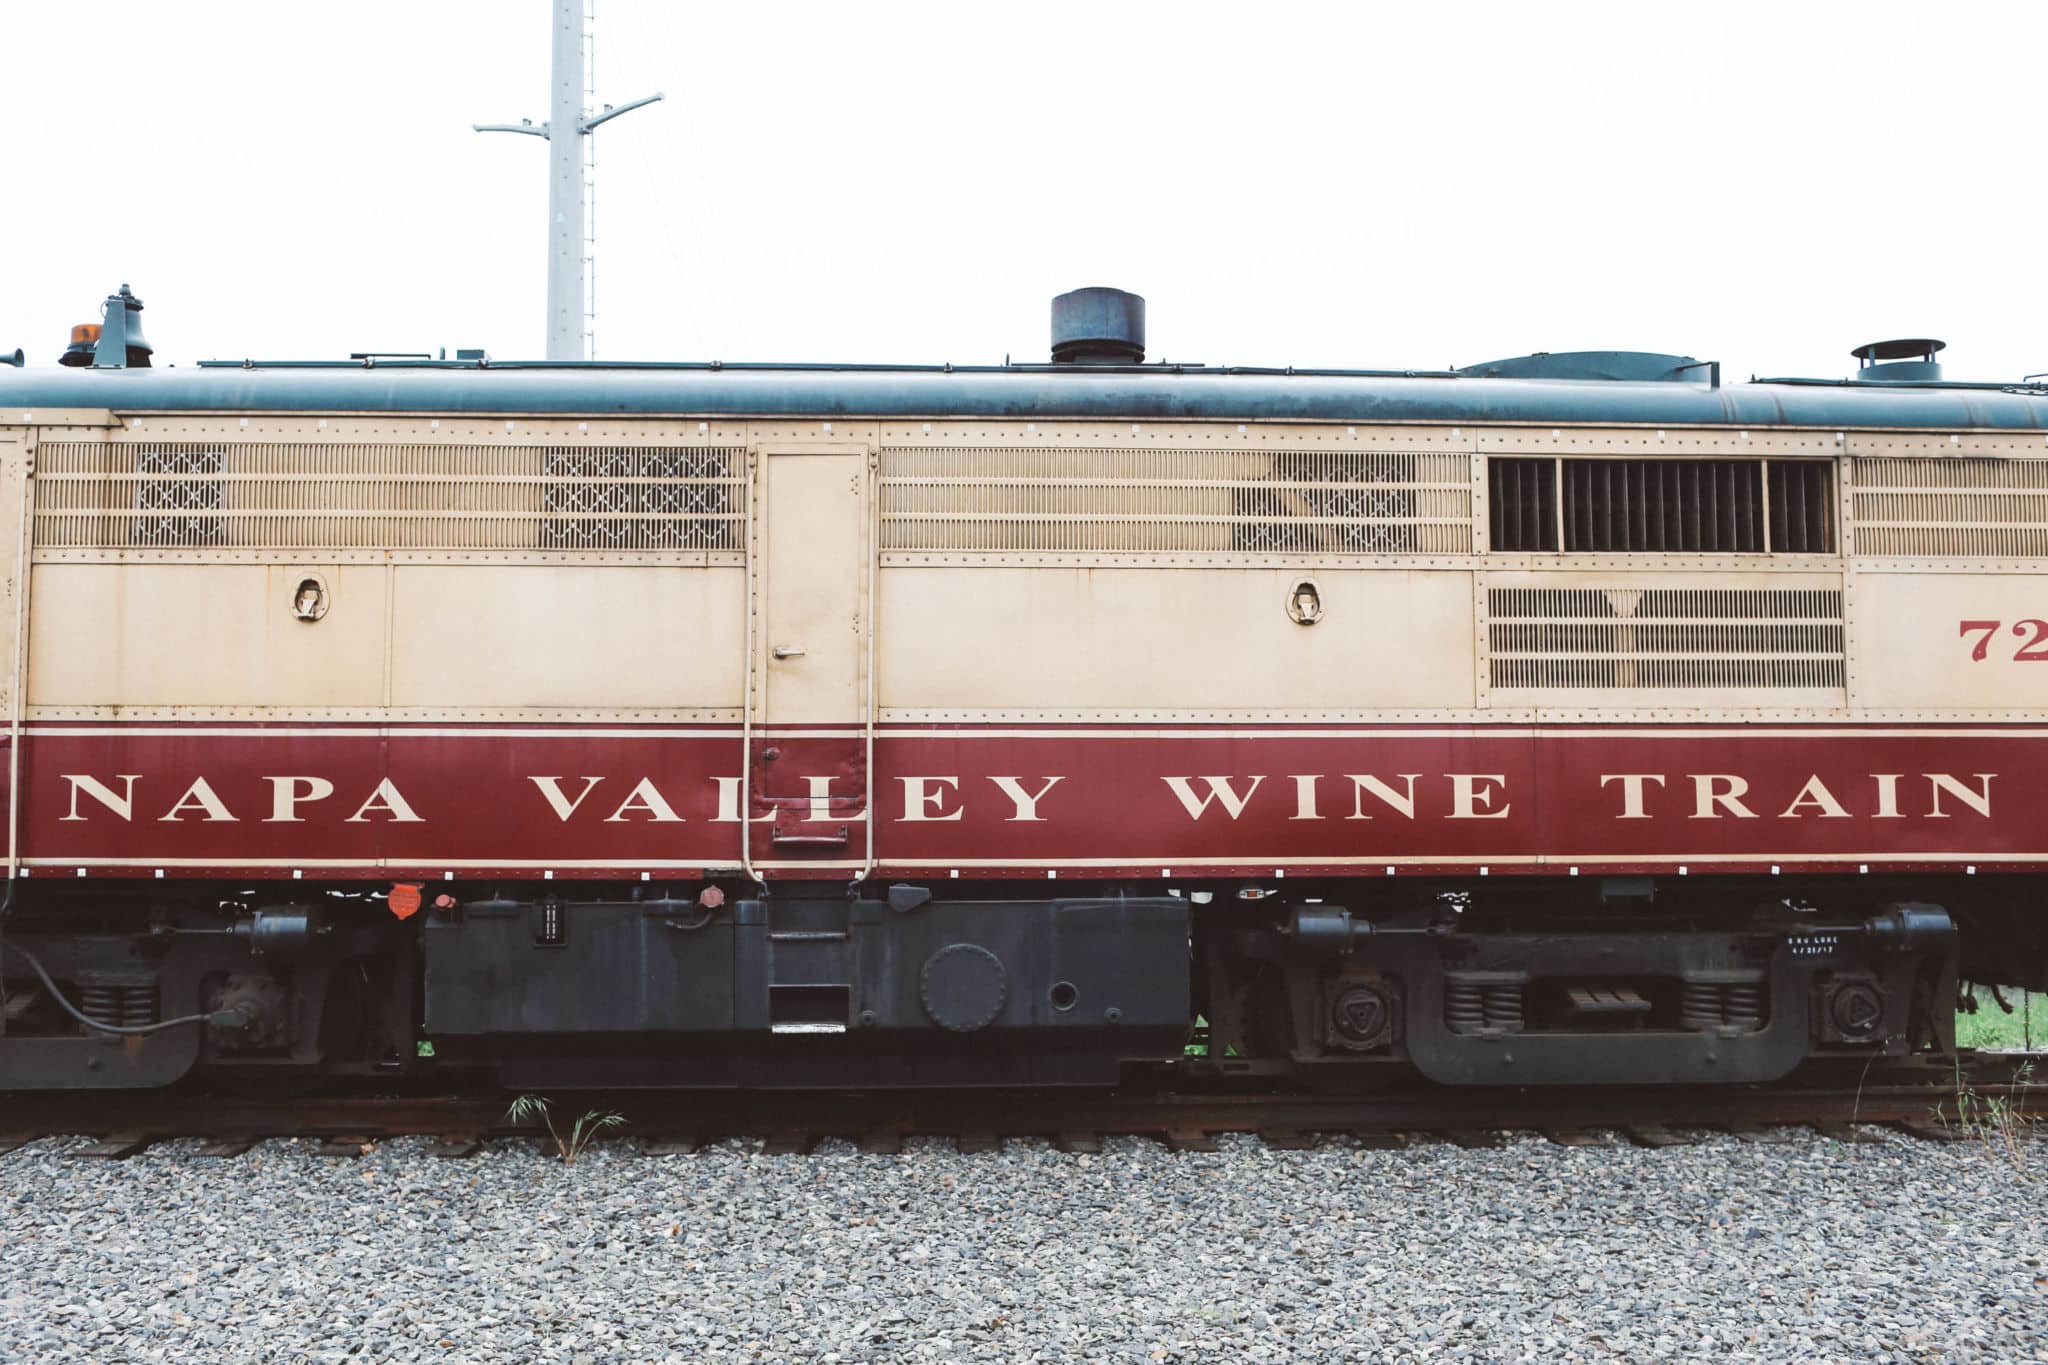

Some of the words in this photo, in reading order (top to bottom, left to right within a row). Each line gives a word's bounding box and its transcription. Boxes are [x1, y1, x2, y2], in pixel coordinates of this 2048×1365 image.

[1960, 619, 2048, 662] 72
[59, 774, 426, 822] NAPA
[527, 775, 1066, 823] VALLEY
[1160, 773, 1511, 820] WINE
[1600, 773, 1999, 819] TRAIN
